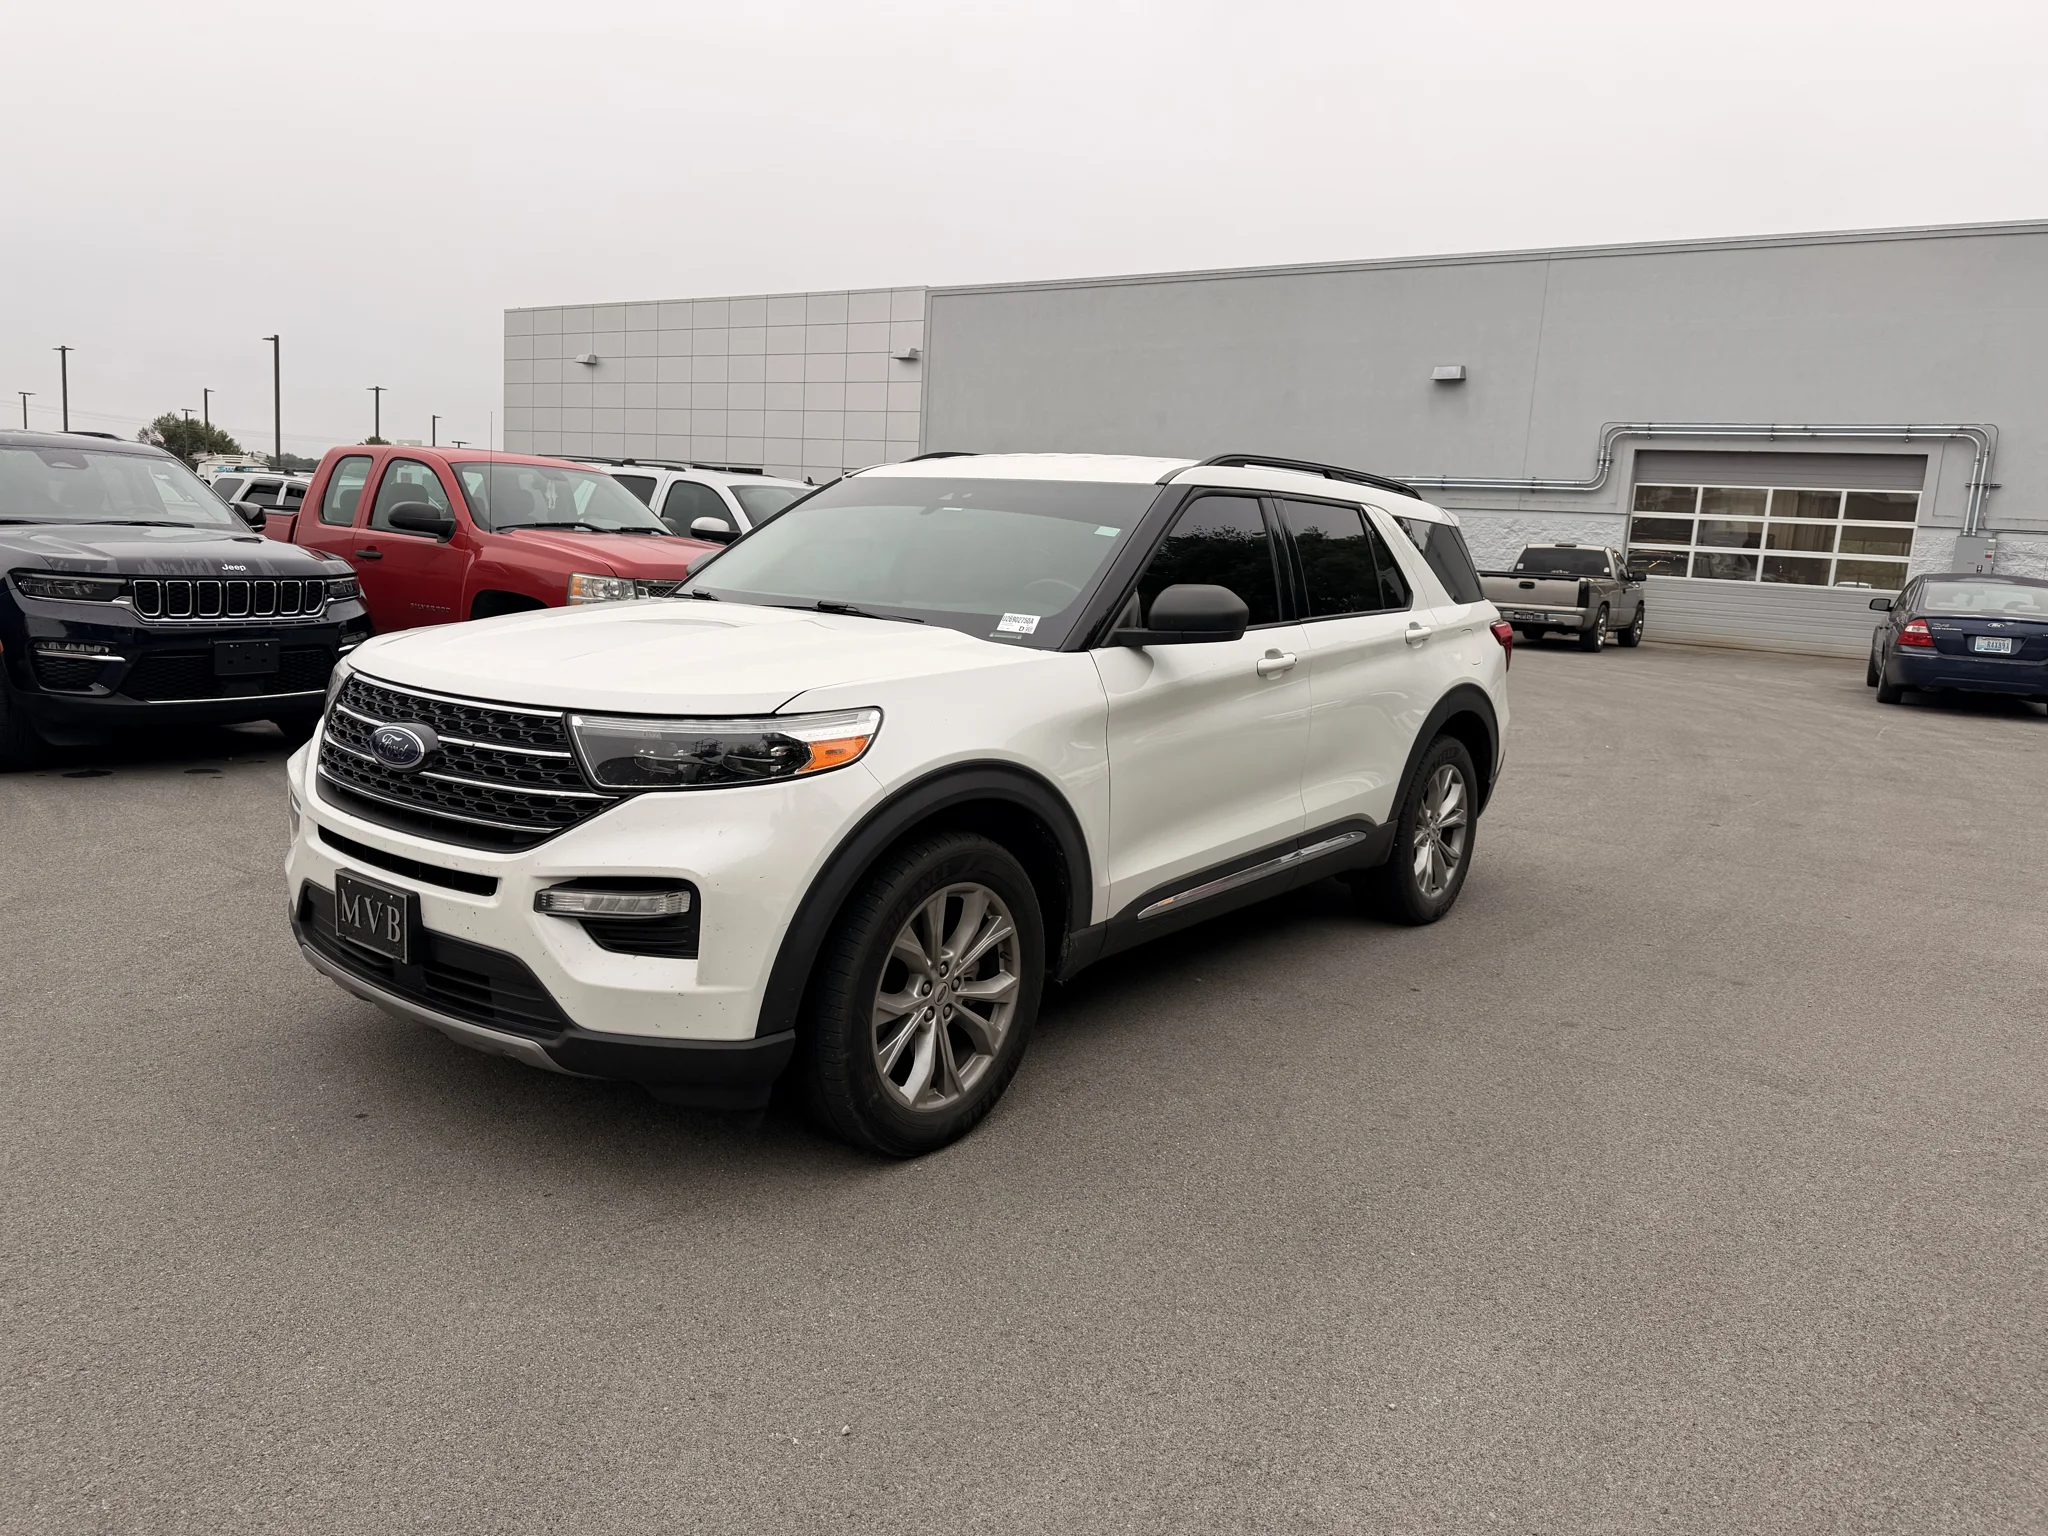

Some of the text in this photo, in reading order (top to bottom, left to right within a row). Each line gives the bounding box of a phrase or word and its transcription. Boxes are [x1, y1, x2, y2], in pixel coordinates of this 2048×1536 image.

[221, 563, 247, 572] Jeep
[378, 733, 409, 760] Ford
[340, 888, 401, 943] MVB
